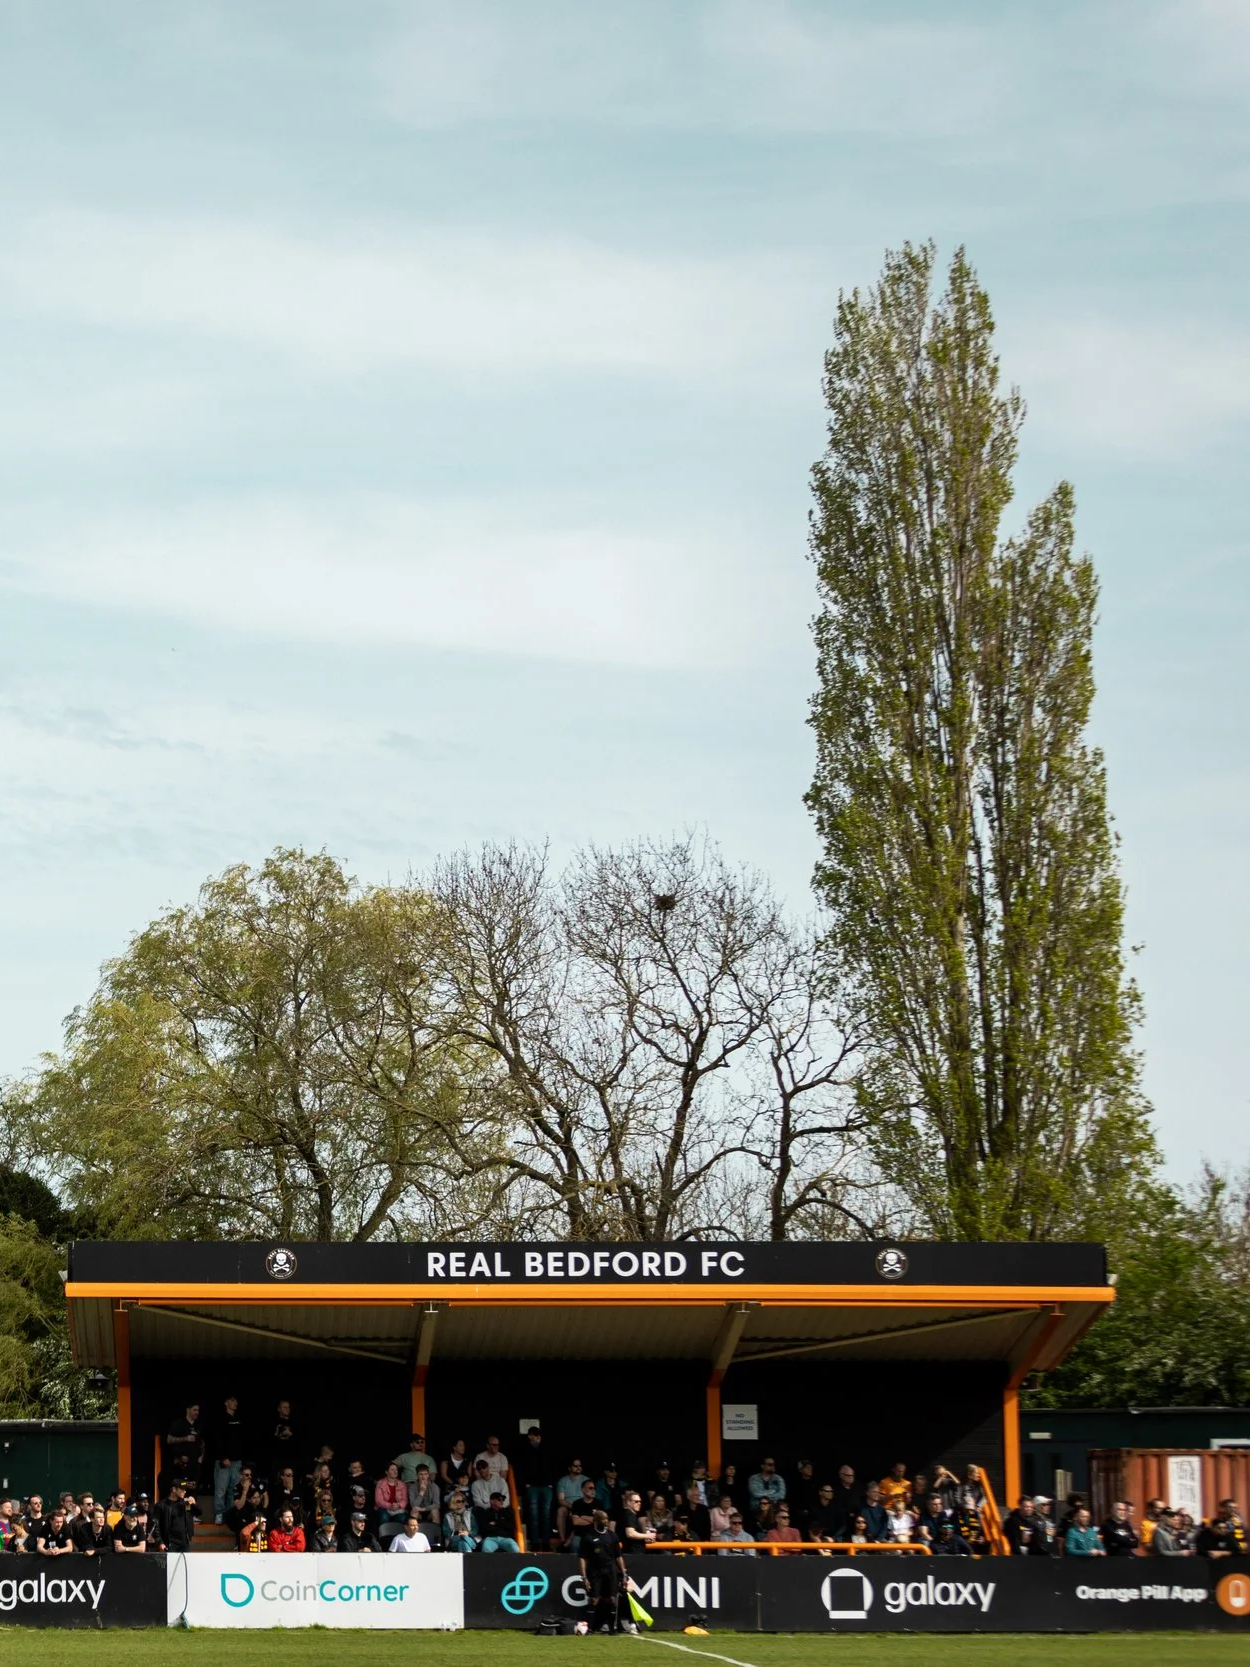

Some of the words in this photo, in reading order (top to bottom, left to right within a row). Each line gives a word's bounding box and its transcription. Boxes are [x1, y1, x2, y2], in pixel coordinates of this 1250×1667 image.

[427, 1251, 512, 1278] REAL
[524, 1250, 688, 1278] BEDFORD
[701, 1250, 746, 1278] FC
[260, 1580, 410, 1602] CoinCorner
[561, 1574, 720, 1608] GMINI
[883, 1575, 996, 1614] galaxy
[1075, 1585, 1141, 1603] Orange
[1141, 1584, 1169, 1600] Pill
[1170, 1585, 1209, 1603] App
